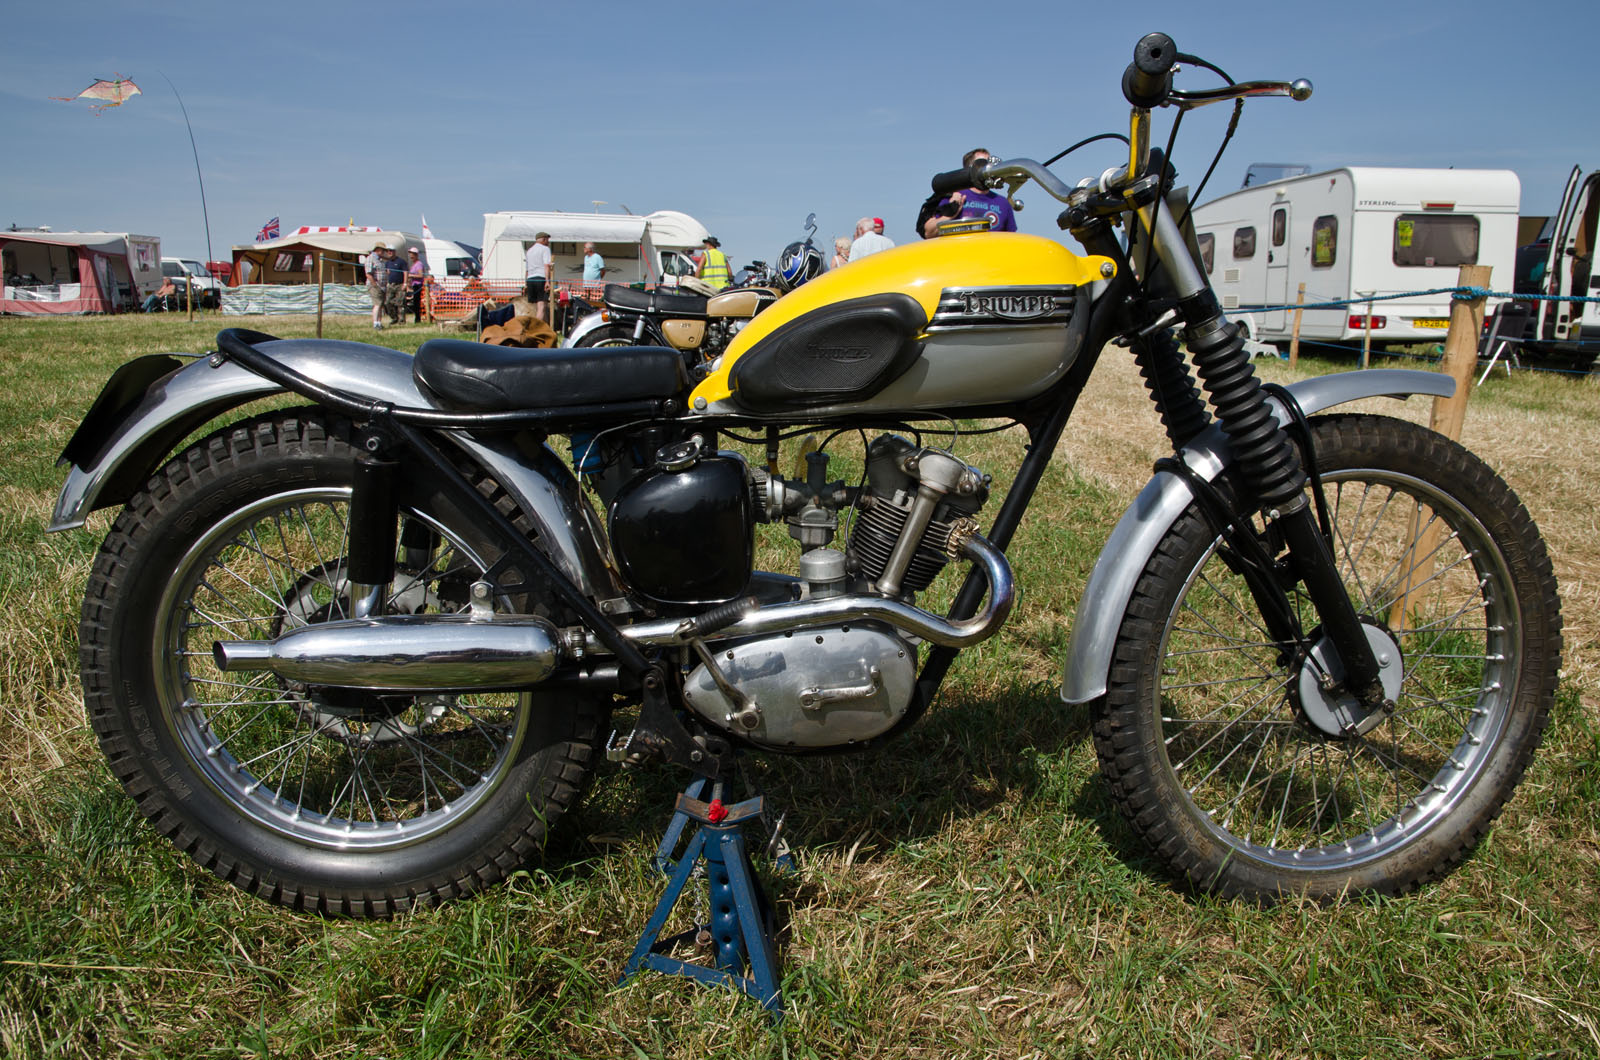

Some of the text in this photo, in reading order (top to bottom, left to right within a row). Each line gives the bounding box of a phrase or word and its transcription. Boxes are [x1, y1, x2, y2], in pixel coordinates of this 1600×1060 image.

[1359, 199, 1397, 207] STERLING
[990, 204, 1002, 214] OIL
[960, 291, 1057, 320] TRIUMPH
